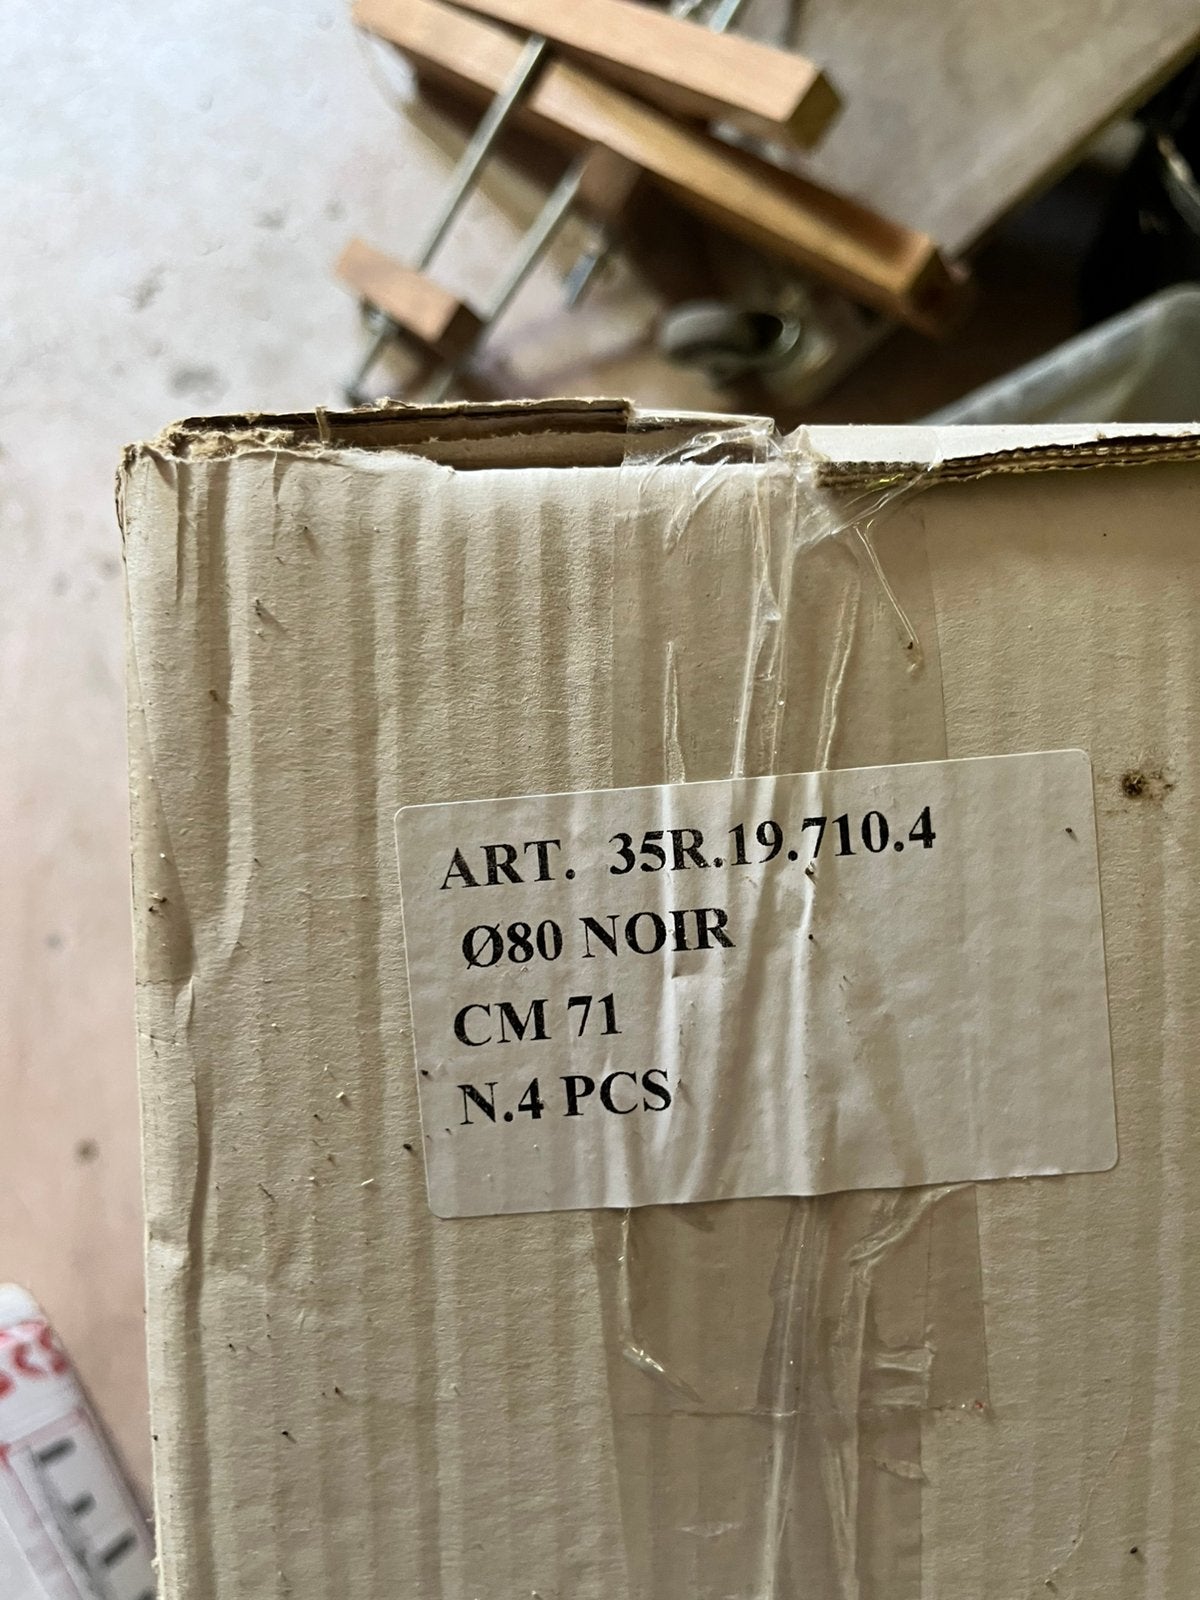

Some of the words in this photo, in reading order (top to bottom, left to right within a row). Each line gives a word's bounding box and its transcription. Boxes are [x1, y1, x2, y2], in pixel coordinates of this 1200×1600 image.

[440, 838, 576, 890] ART.
[608, 806, 936, 875] 35R.19.710.4
[461, 918, 563, 970] Ø80
[579, 907, 735, 958] NOIR
[453, 999, 551, 1046] CM
[567, 993, 622, 1038] 71
[458, 1079, 544, 1125] N.4
[561, 1068, 673, 1117] PCS
